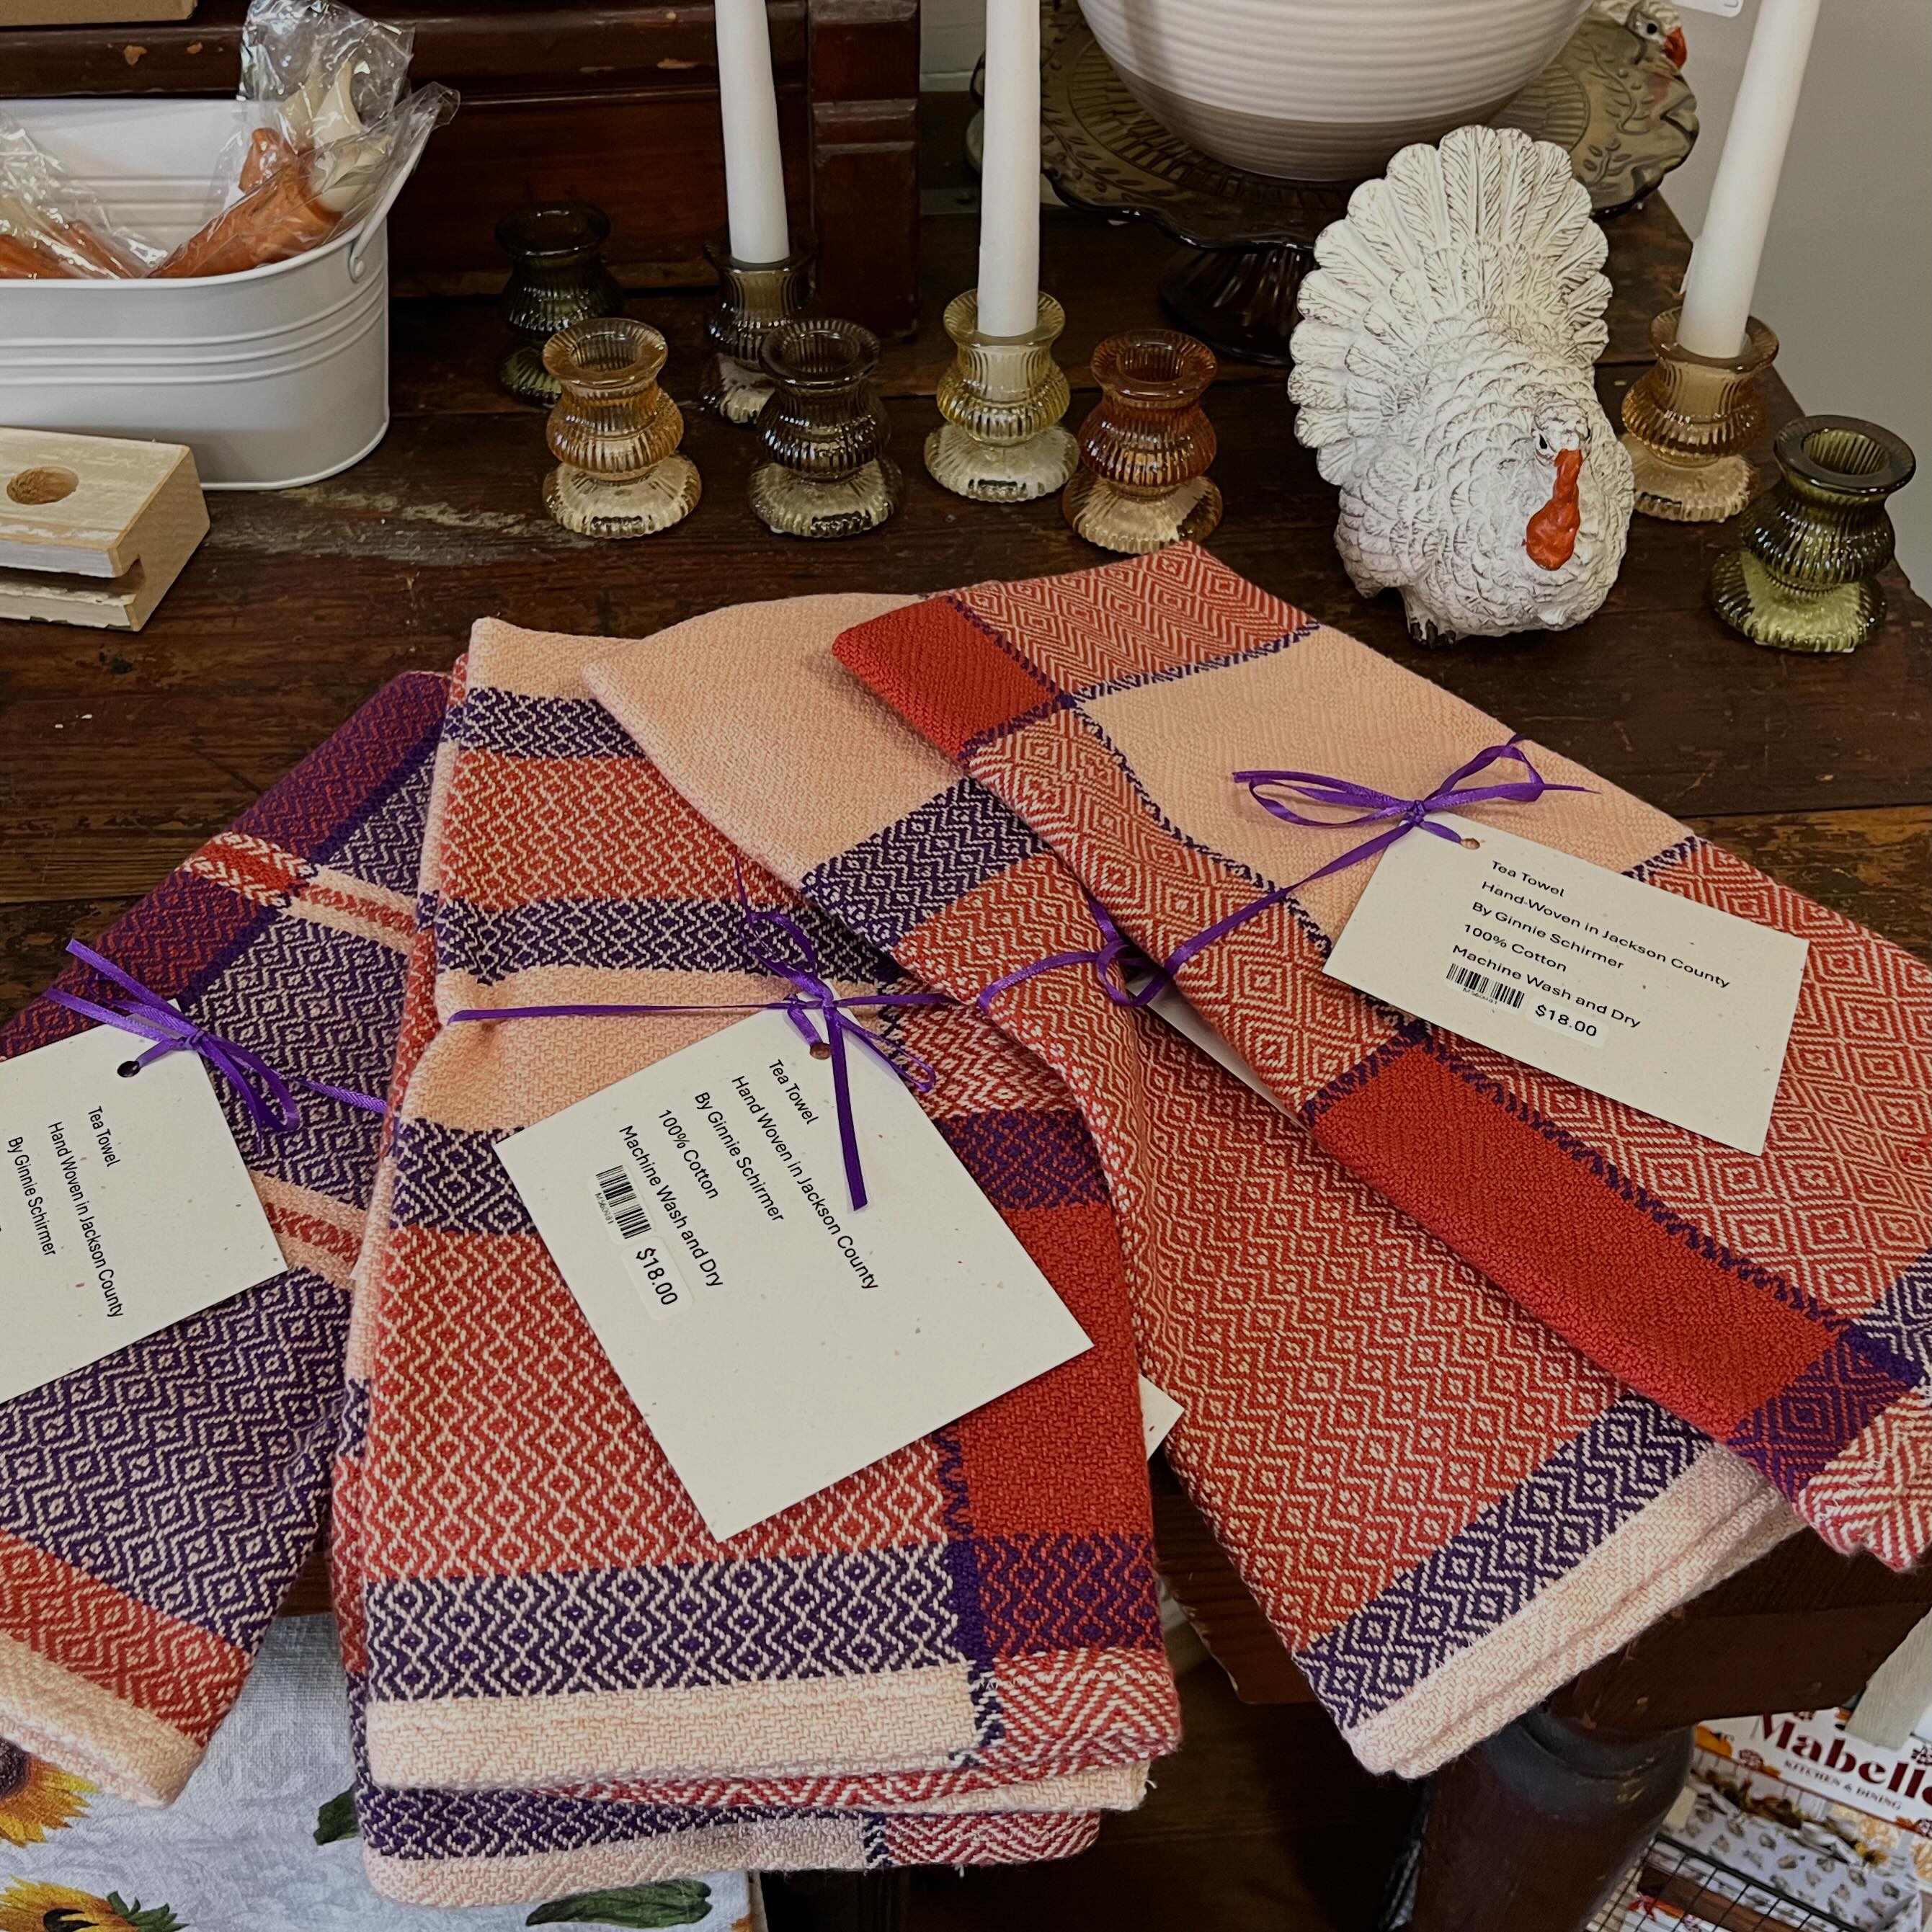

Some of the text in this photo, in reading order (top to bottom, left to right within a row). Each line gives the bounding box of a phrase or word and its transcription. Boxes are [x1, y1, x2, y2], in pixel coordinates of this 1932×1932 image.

[1492, 860, 1564, 897] Tea Towel
[1464, 924, 1567, 972] 100% Cotton
[1472, 902, 1624, 969] By Ginnie Schirmer
[1585, 922, 1599, 935] in
[1602, 930, 1666, 963] Jackson
[1670, 958, 1730, 989] County
[1452, 945, 1641, 1028] Machine Wash and Dry
[1535, 1004, 1597, 1036] $18.00
[769, 1059, 819, 1125] Tea Towel
[88, 1105, 121, 1167] Tea Towel
[658, 1109, 718, 1199] 100% Cotton
[694, 1092, 784, 1221] By Ginnie Schirmer
[6, 1136, 56, 1256] By Ginnie Schirmer
[618, 1125, 724, 1286] Machine Wash and Dry
[731, 1075, 879, 1289] Hand Woven in Jackson County
[48, 1121, 124, 1317] Hand Woven in Jackson County
[636, 1247, 678, 1305] $18.00
[1784, 1758, 1902, 1811] KITCHEN & DINING
